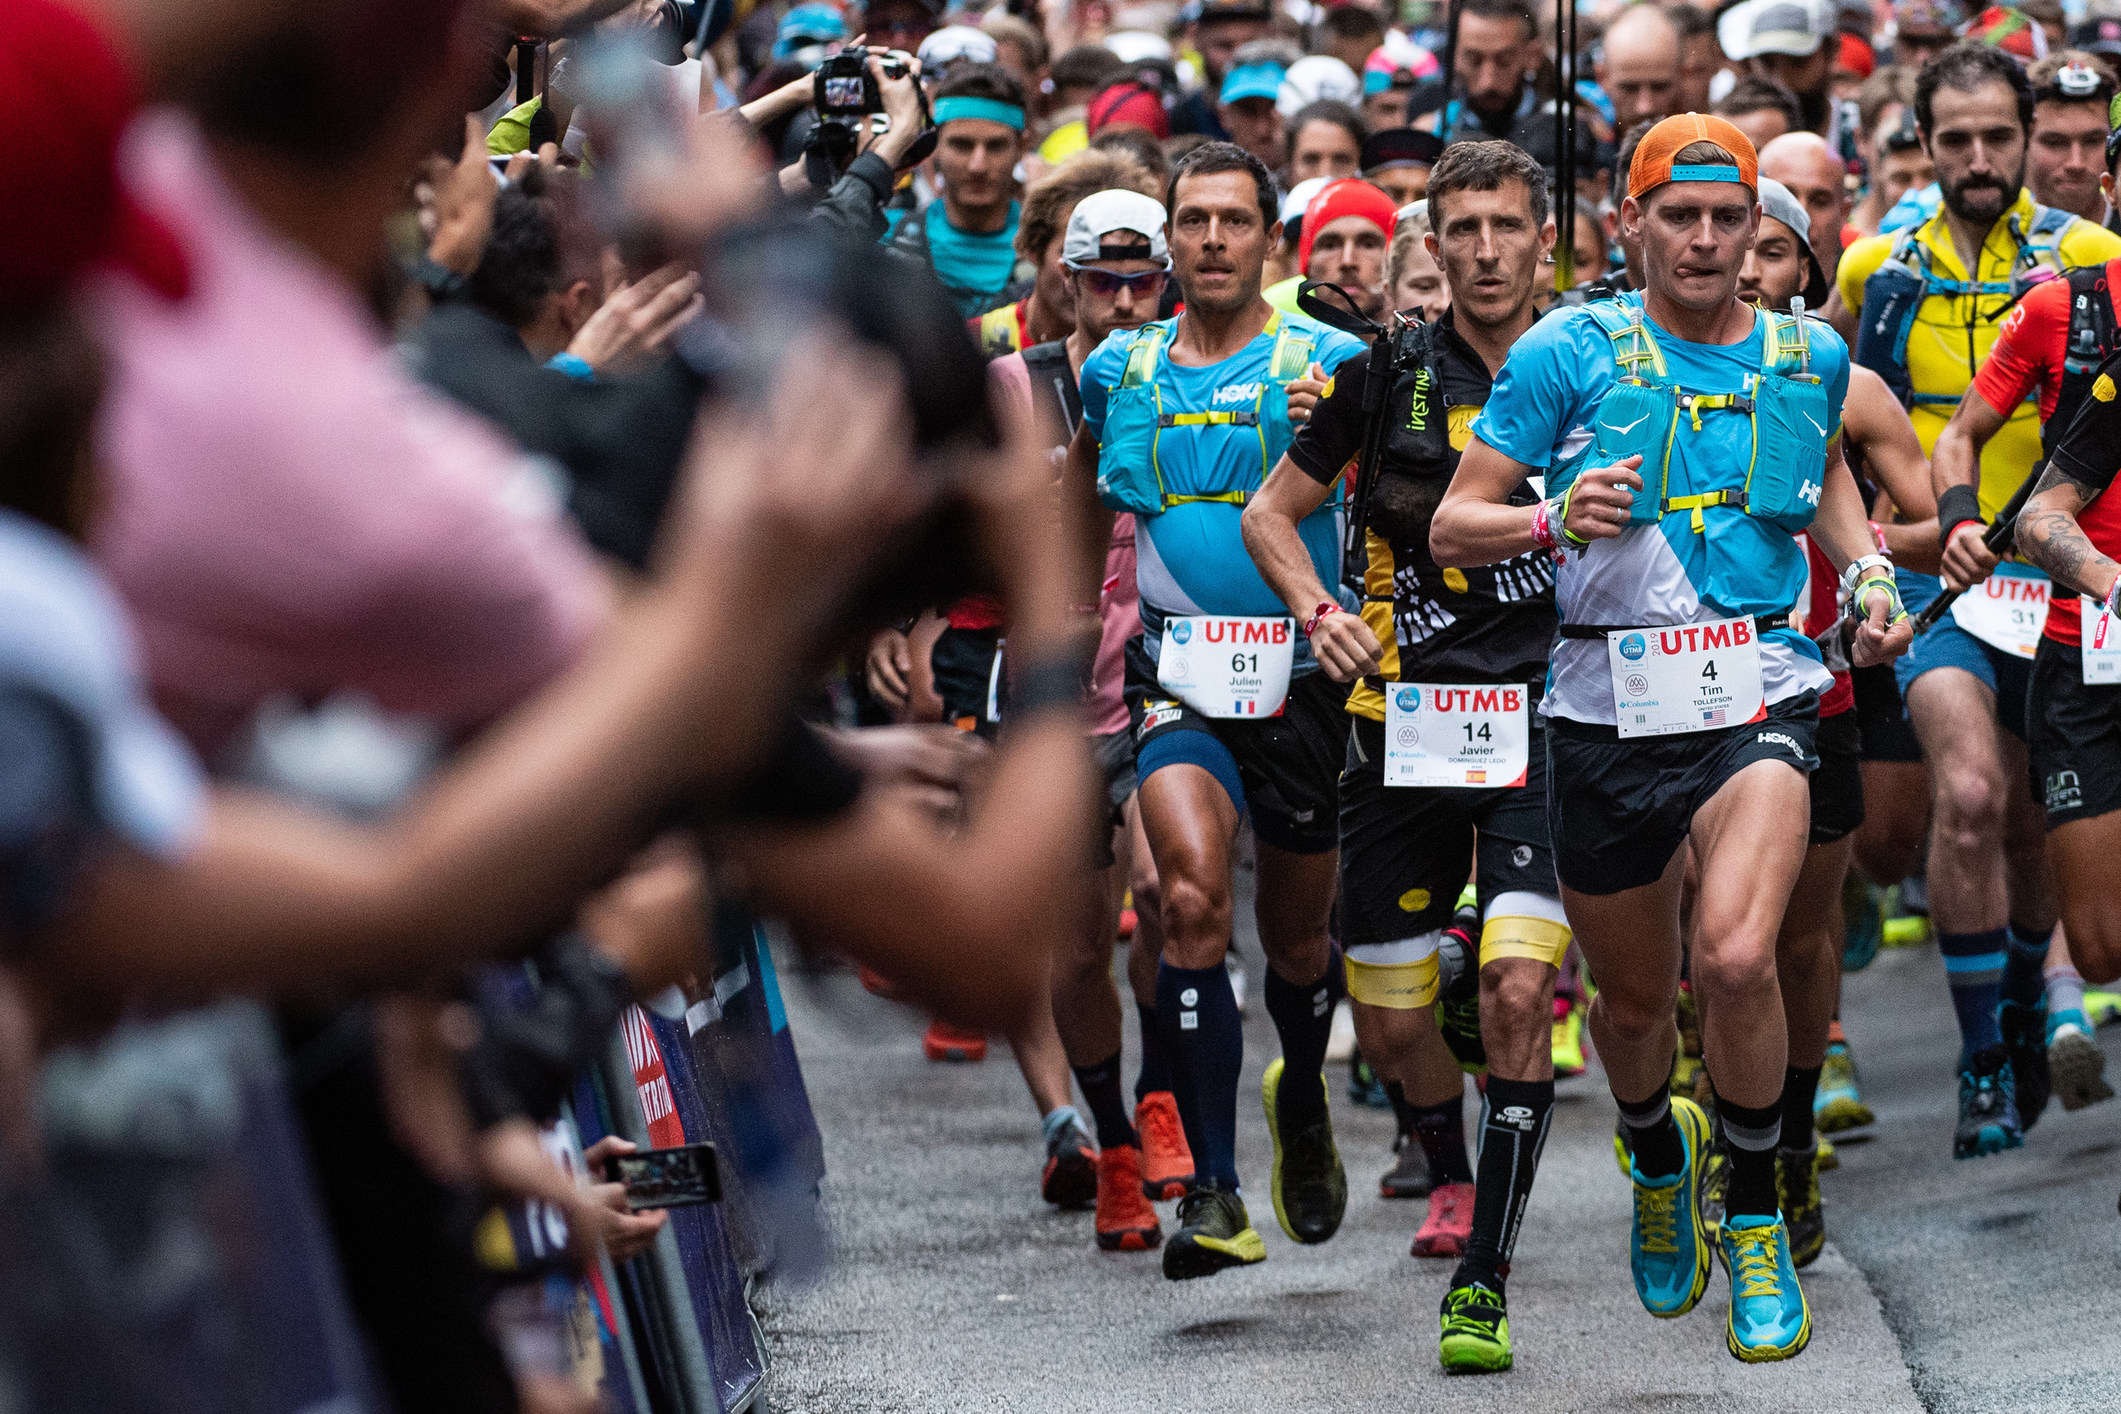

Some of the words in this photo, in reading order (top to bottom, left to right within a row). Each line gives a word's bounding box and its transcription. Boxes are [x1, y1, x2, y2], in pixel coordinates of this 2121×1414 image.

[1986, 577, 2047, 604] UTM
[2011, 609, 2036, 626] 31
[1205, 621, 1287, 644] UTMB
[1660, 621, 1750, 655] UTMB
[1650, 632, 1661, 656] 2019
[1231, 653, 1257, 673] 61
[1701, 659, 1718, 681] 4
[1229, 676, 1262, 686] Julien
[1700, 685, 1723, 696] Tim
[1425, 688, 1433, 711] 2019
[1434, 688, 1520, 713] UTMB
[1626, 699, 1659, 708] Columbia
[1692, 695, 1733, 706] TOLLEFSON
[1463, 721, 1492, 742] 14
[1396, 751, 1427, 759] Columbia
[1460, 745, 1495, 755] Javier
